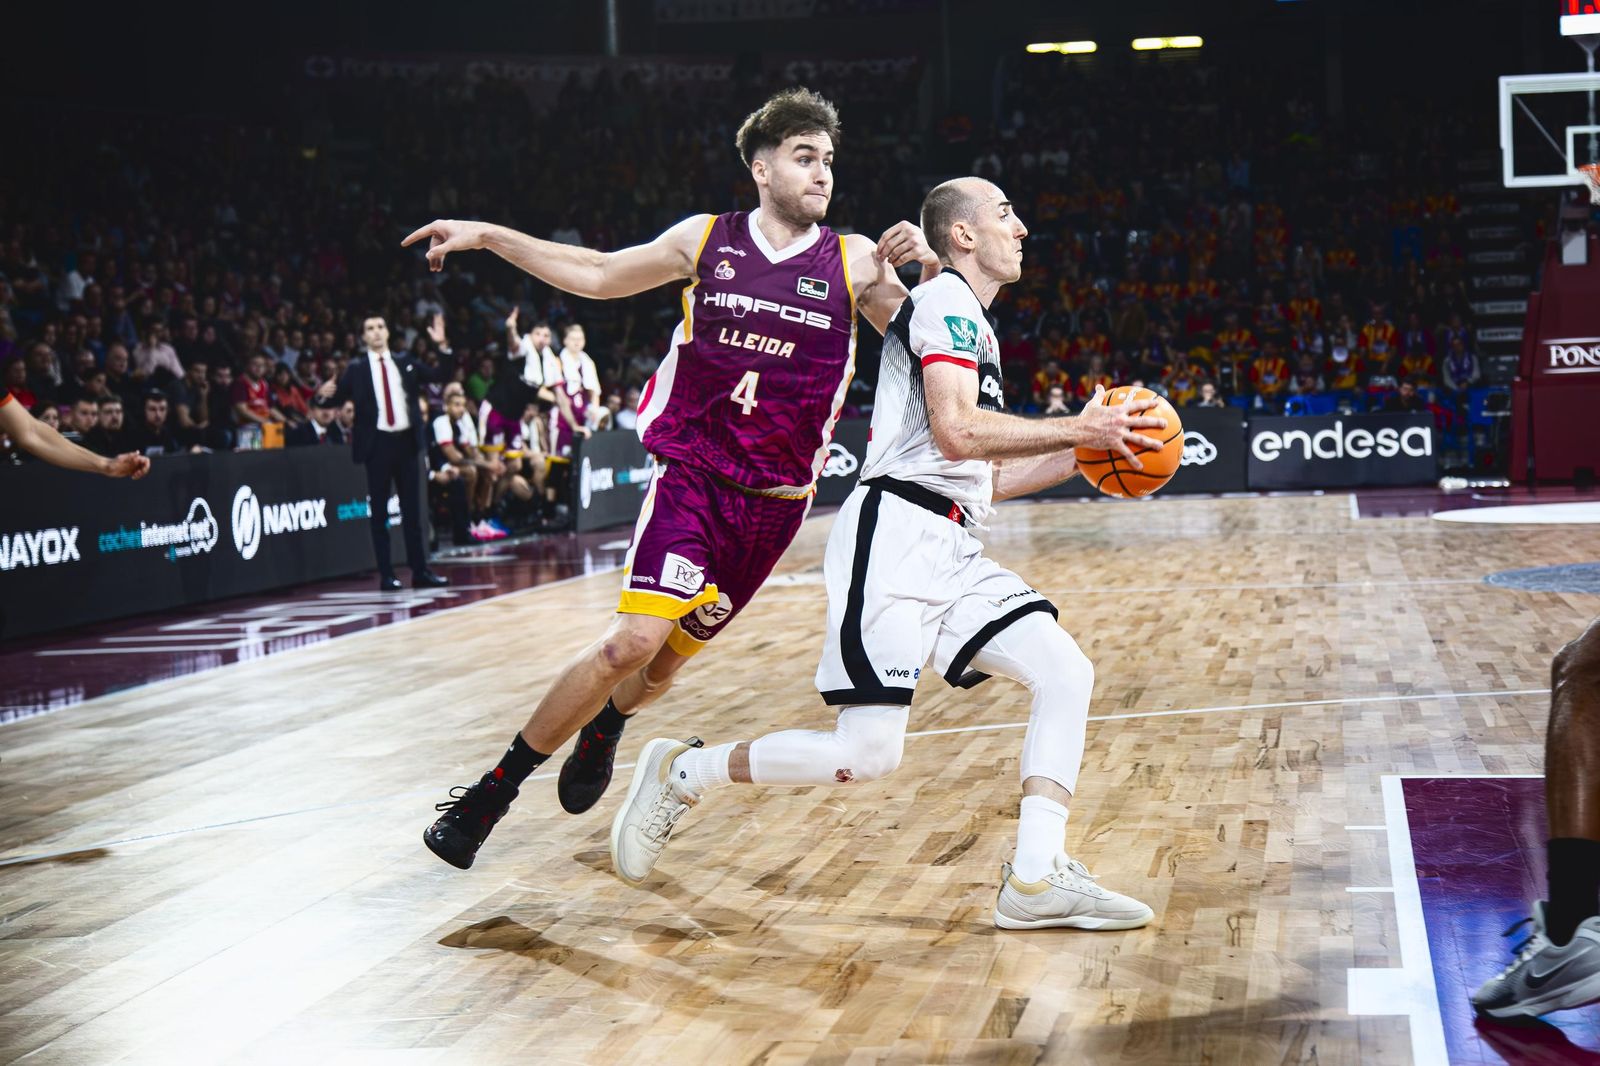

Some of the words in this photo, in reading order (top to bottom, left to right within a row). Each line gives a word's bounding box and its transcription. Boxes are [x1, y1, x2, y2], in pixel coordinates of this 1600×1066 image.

[719, 328, 796, 358] LLEIDA
[730, 370, 760, 415] 4
[1251, 420, 1433, 462] endesa
[263, 499, 328, 535] NAYOX
[885, 667, 910, 679] vive
